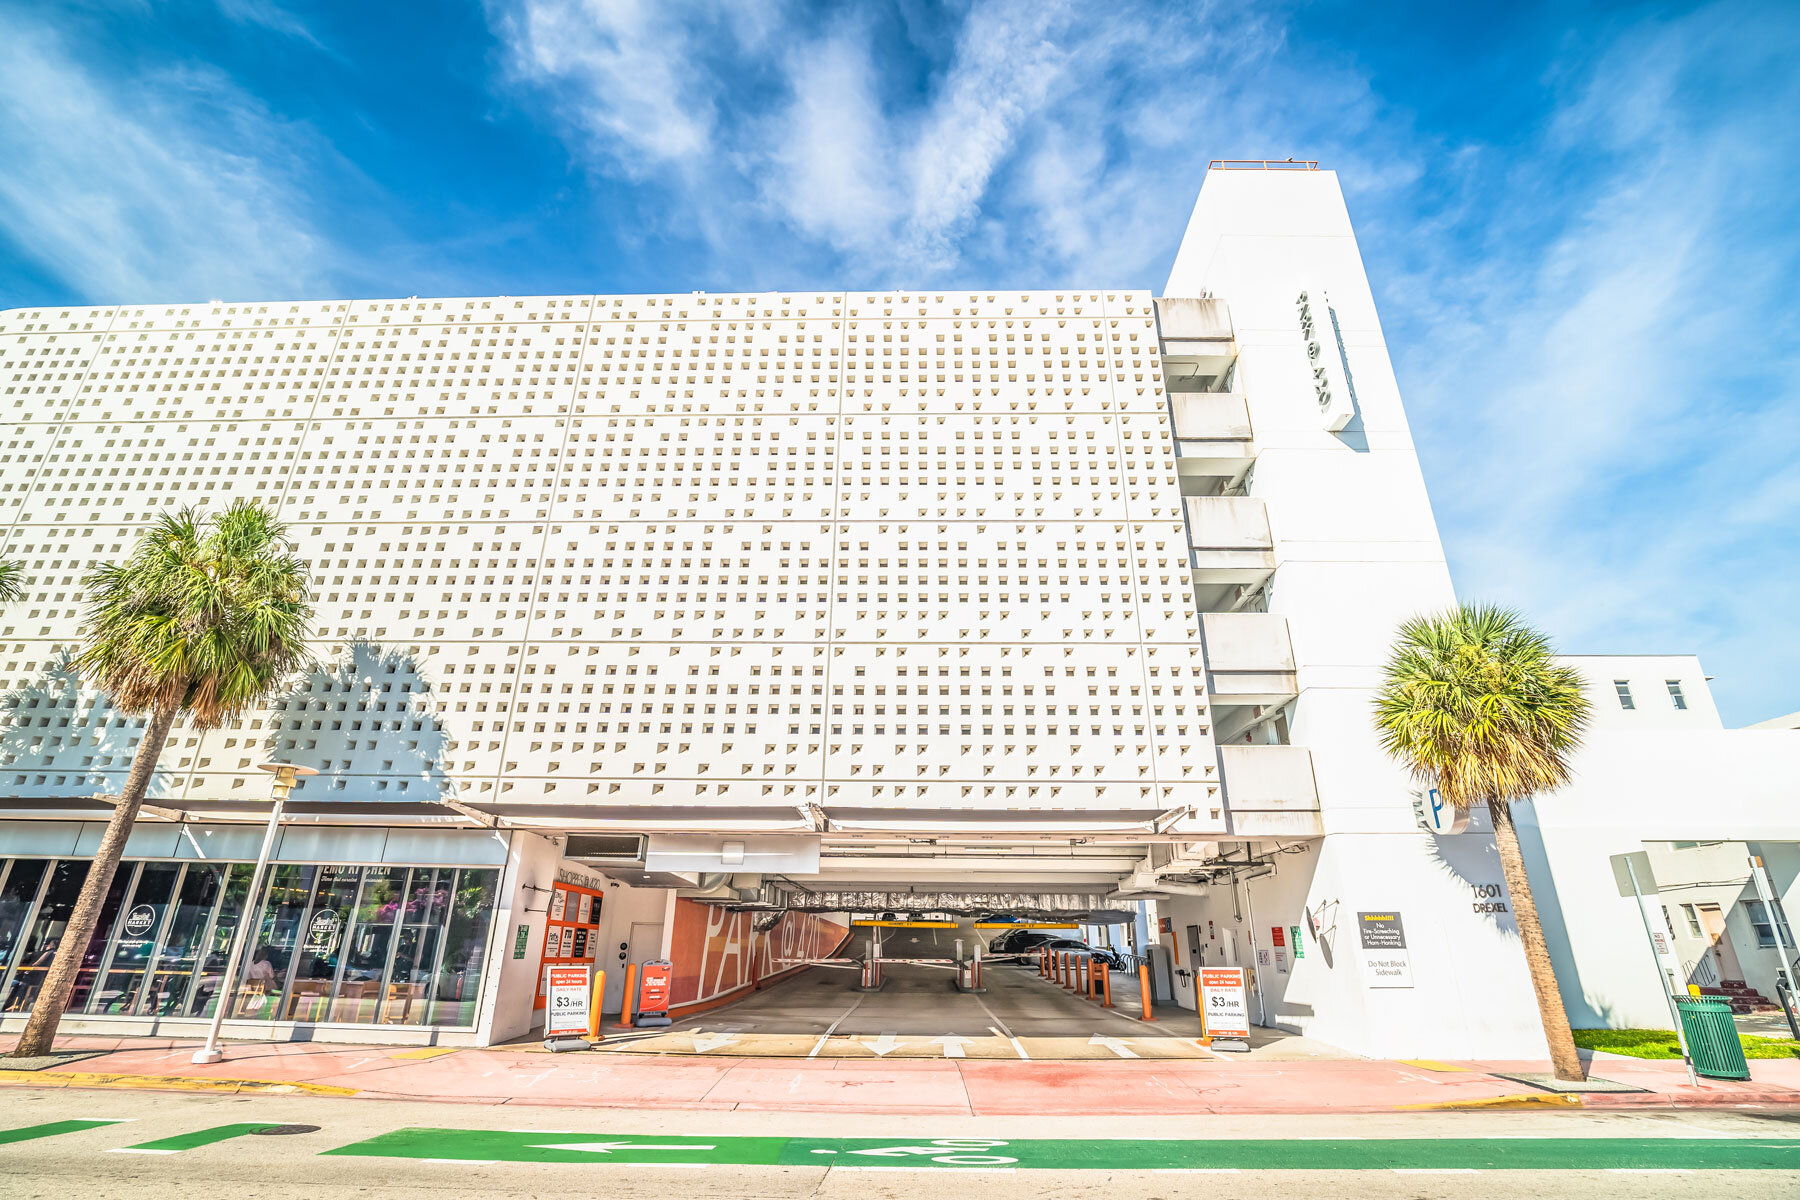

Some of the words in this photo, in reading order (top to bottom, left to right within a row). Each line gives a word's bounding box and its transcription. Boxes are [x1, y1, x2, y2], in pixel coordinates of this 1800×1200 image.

[1471, 884, 1502, 898] 1601
[1473, 903, 1508, 913] DREXEL
[1363, 928, 1400, 936] Tire-Screeching
[1370, 934, 1401, 942] Unnecessary
